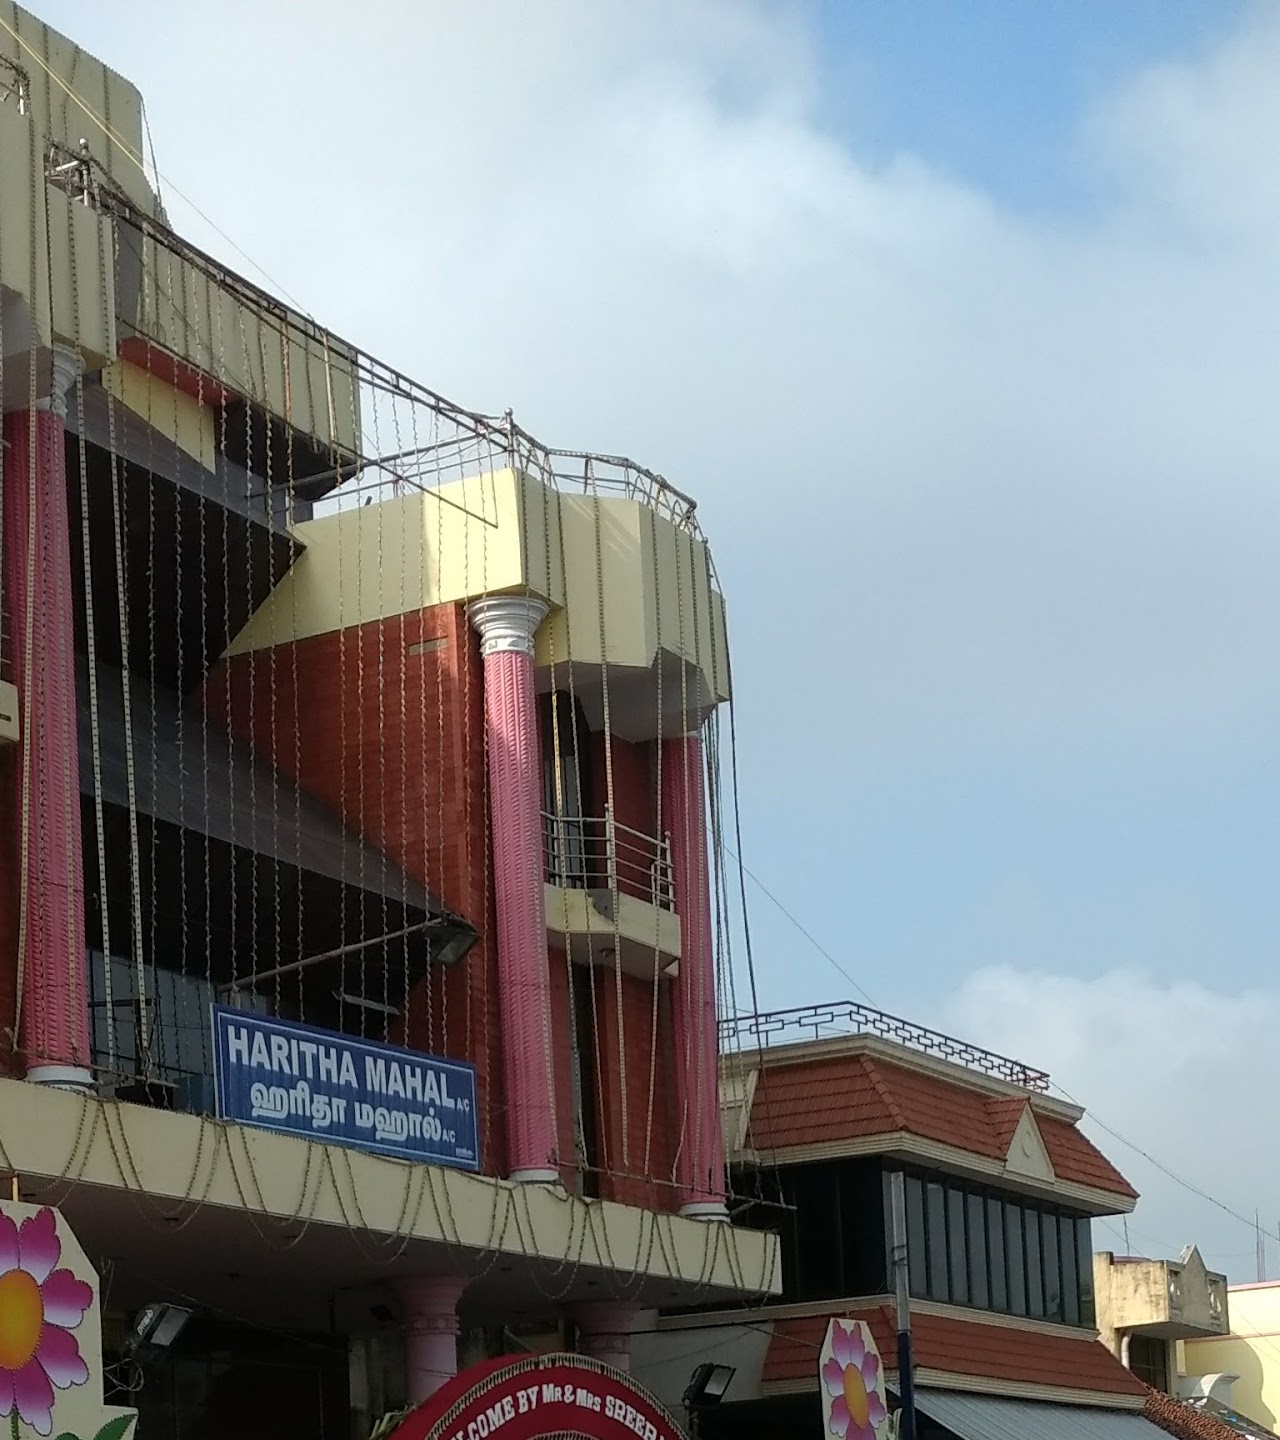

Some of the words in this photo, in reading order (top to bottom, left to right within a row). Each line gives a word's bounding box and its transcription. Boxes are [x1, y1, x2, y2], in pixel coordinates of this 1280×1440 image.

[228, 1025, 358, 1088] HARITHA
[365, 1055, 456, 1109] MAHAL
[251, 1080, 347, 1128] ஹரிதா
[354, 1101, 442, 1141] மஹால்
[516, 1385, 539, 1414] BY
